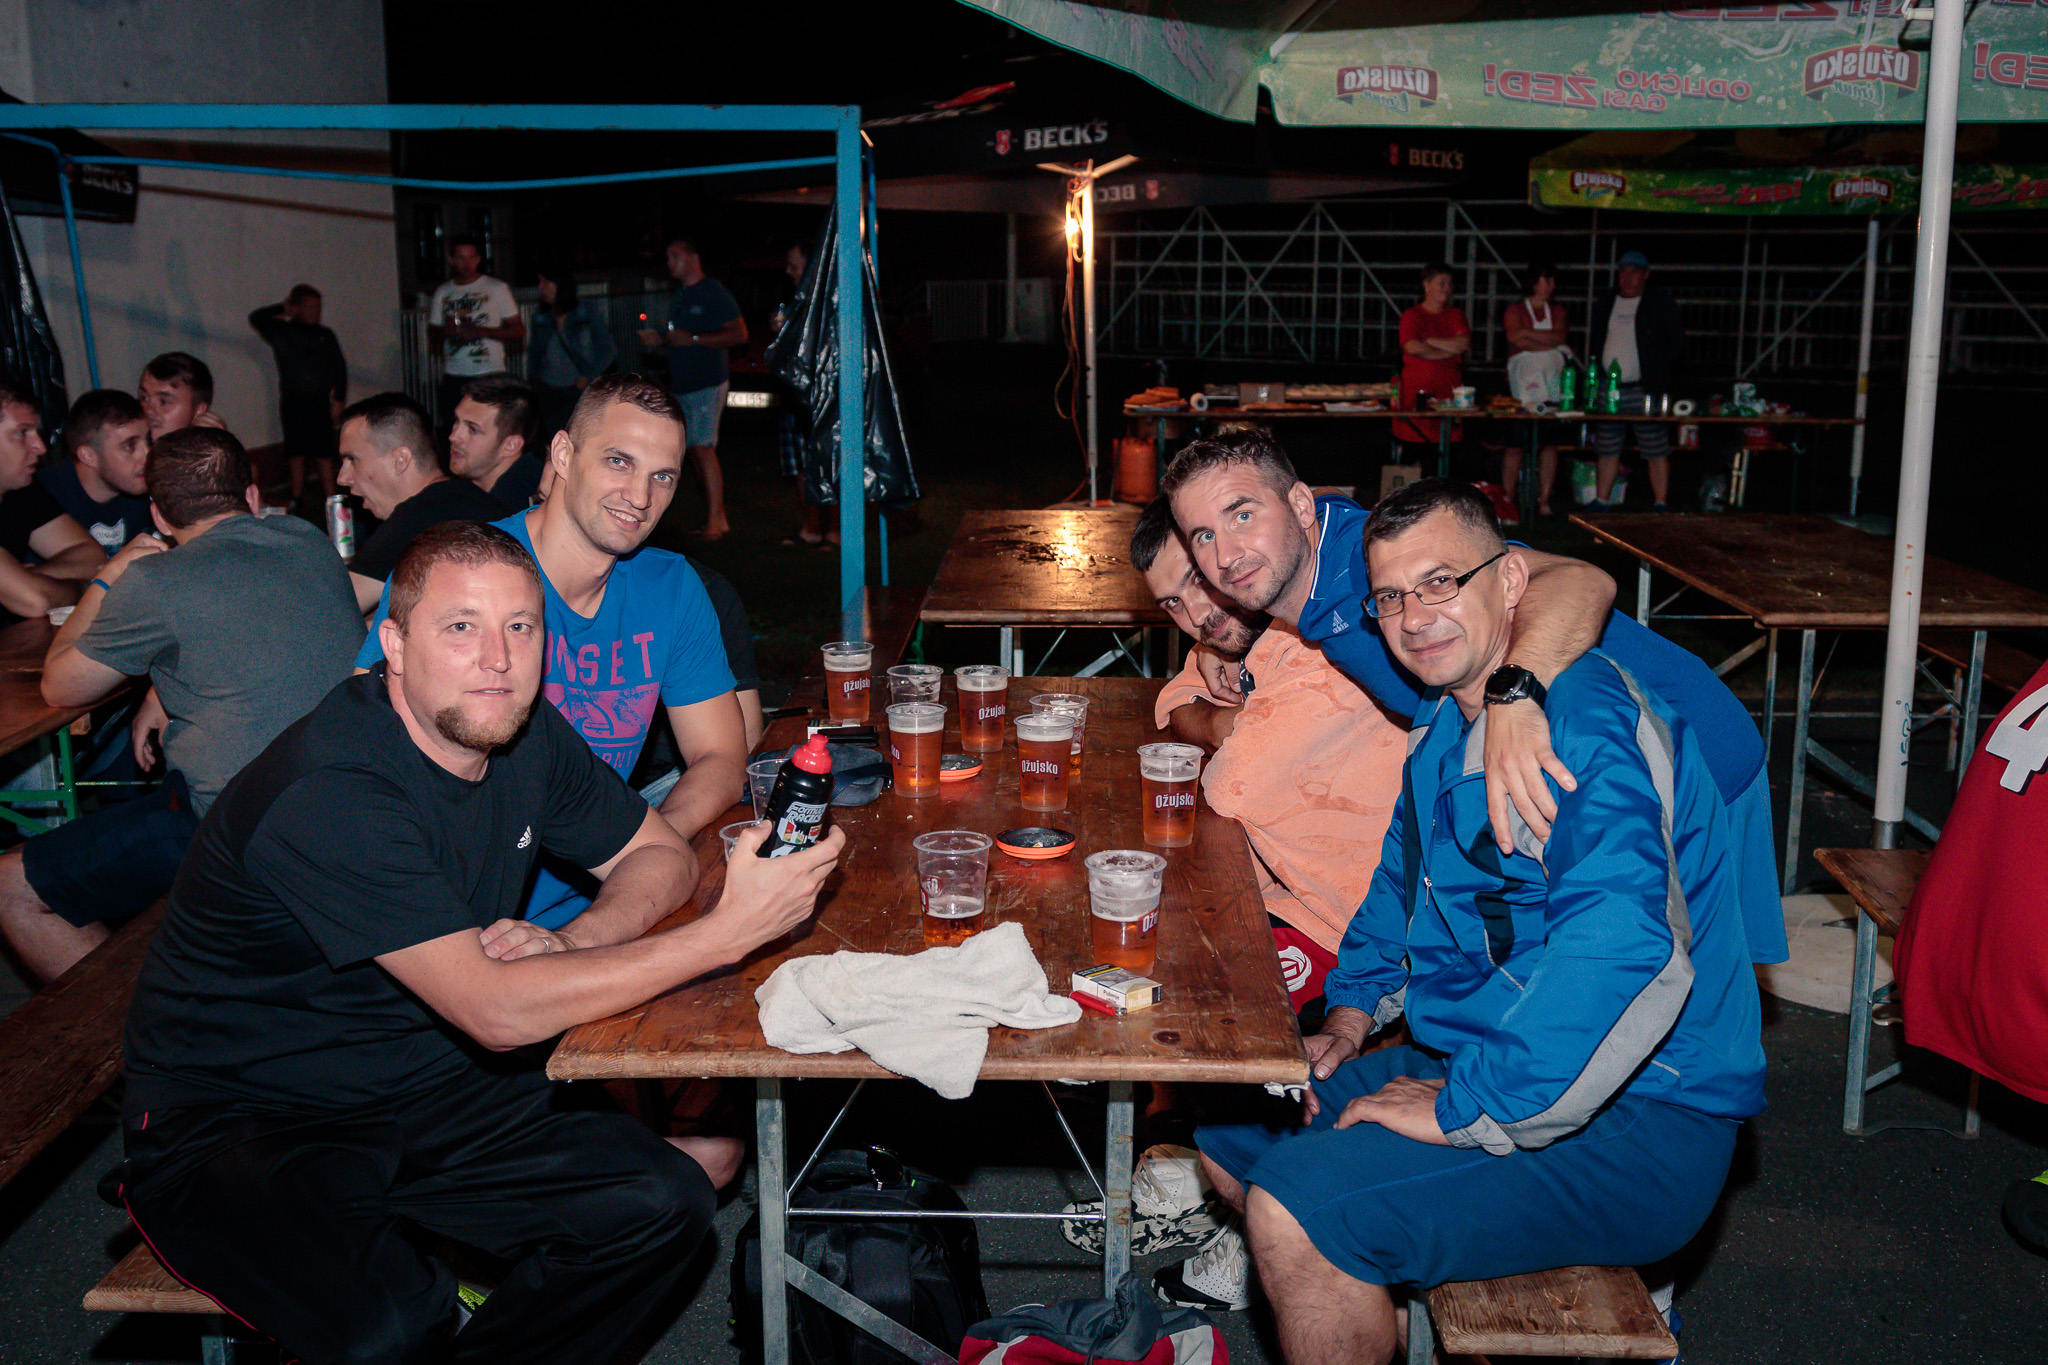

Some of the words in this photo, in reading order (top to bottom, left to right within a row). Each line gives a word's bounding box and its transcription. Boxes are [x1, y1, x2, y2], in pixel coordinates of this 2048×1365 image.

[1023, 119, 1109, 151] BECK'S
[543, 630, 654, 686] NSET
[843, 677, 871, 693] Ožujsk
[978, 704, 1006, 720] Ožujsk
[1021, 760, 1058, 775] Ožujsko
[1155, 793, 1194, 809] Ožujsko
